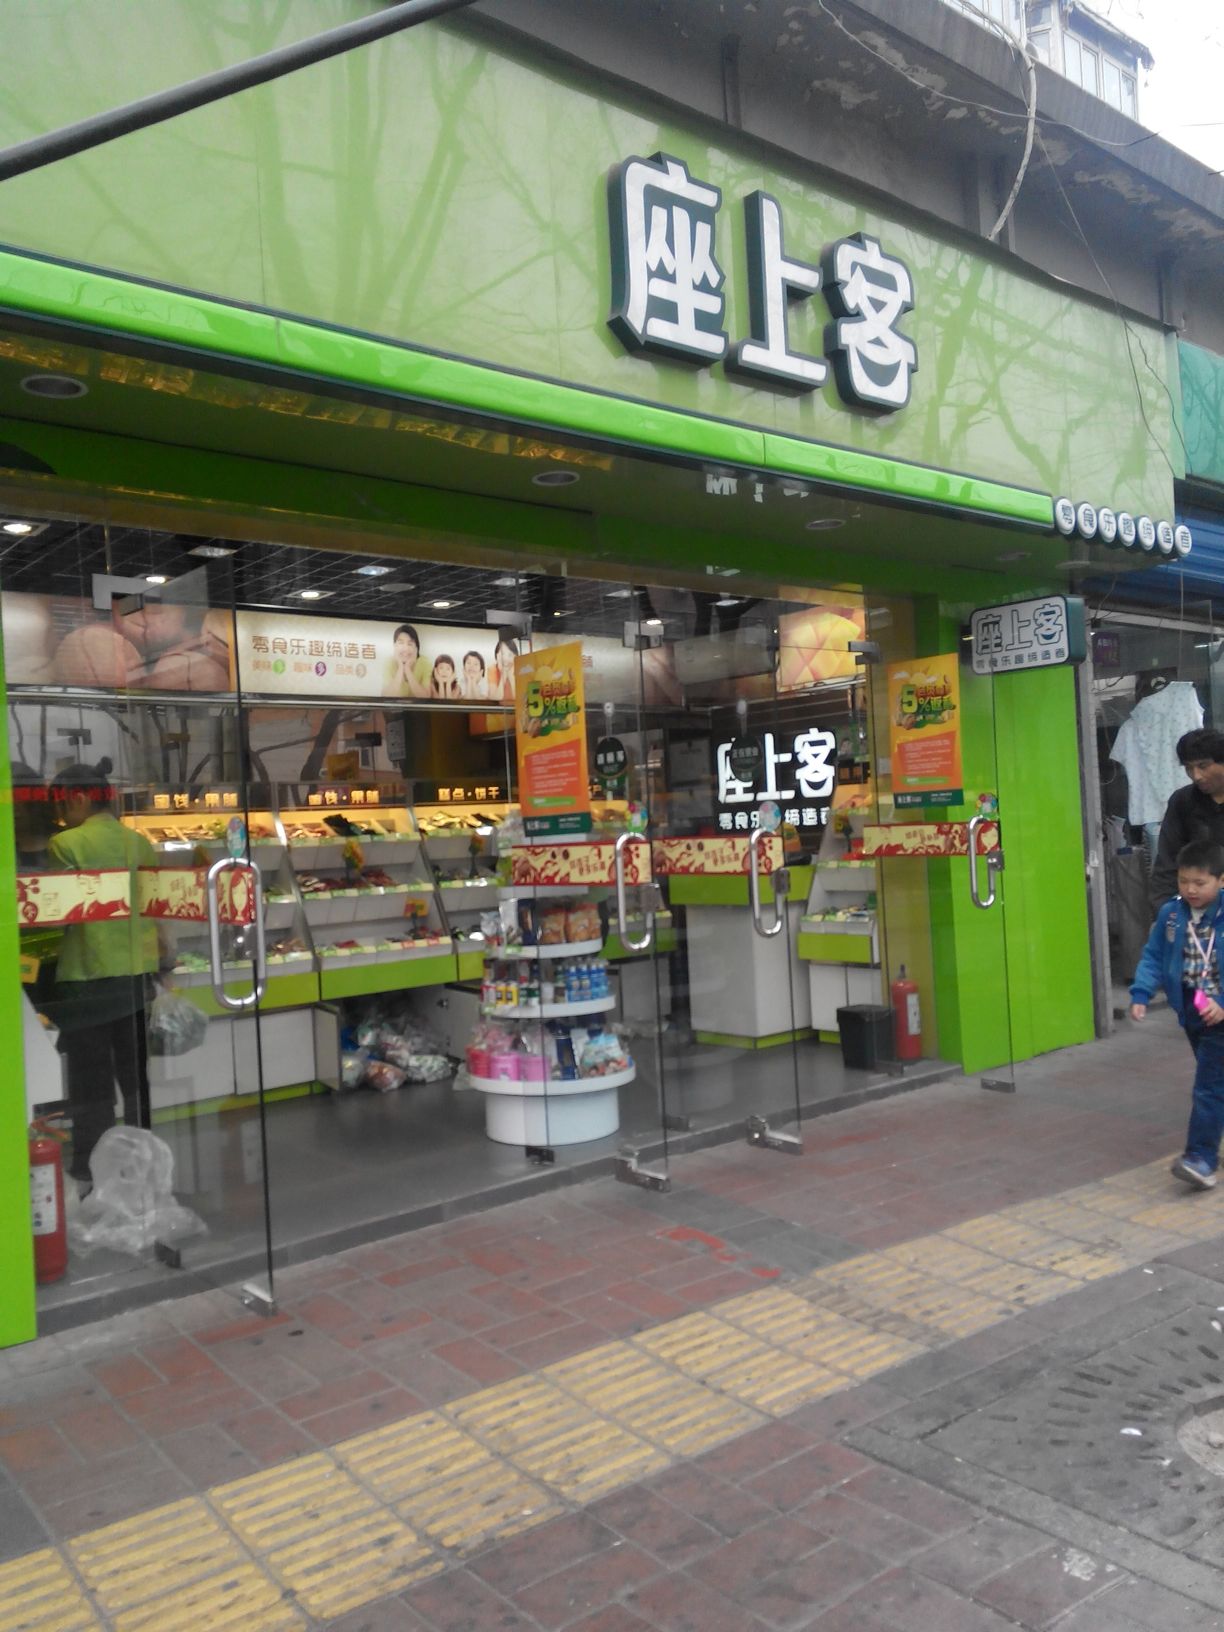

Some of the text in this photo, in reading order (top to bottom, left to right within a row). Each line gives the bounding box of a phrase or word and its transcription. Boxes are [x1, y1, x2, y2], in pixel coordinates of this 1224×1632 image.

[614, 154, 918, 409] 座上客
[251, 635, 376, 659] 零食乐趣缔造者
[976, 603, 1064, 656] 座上客
